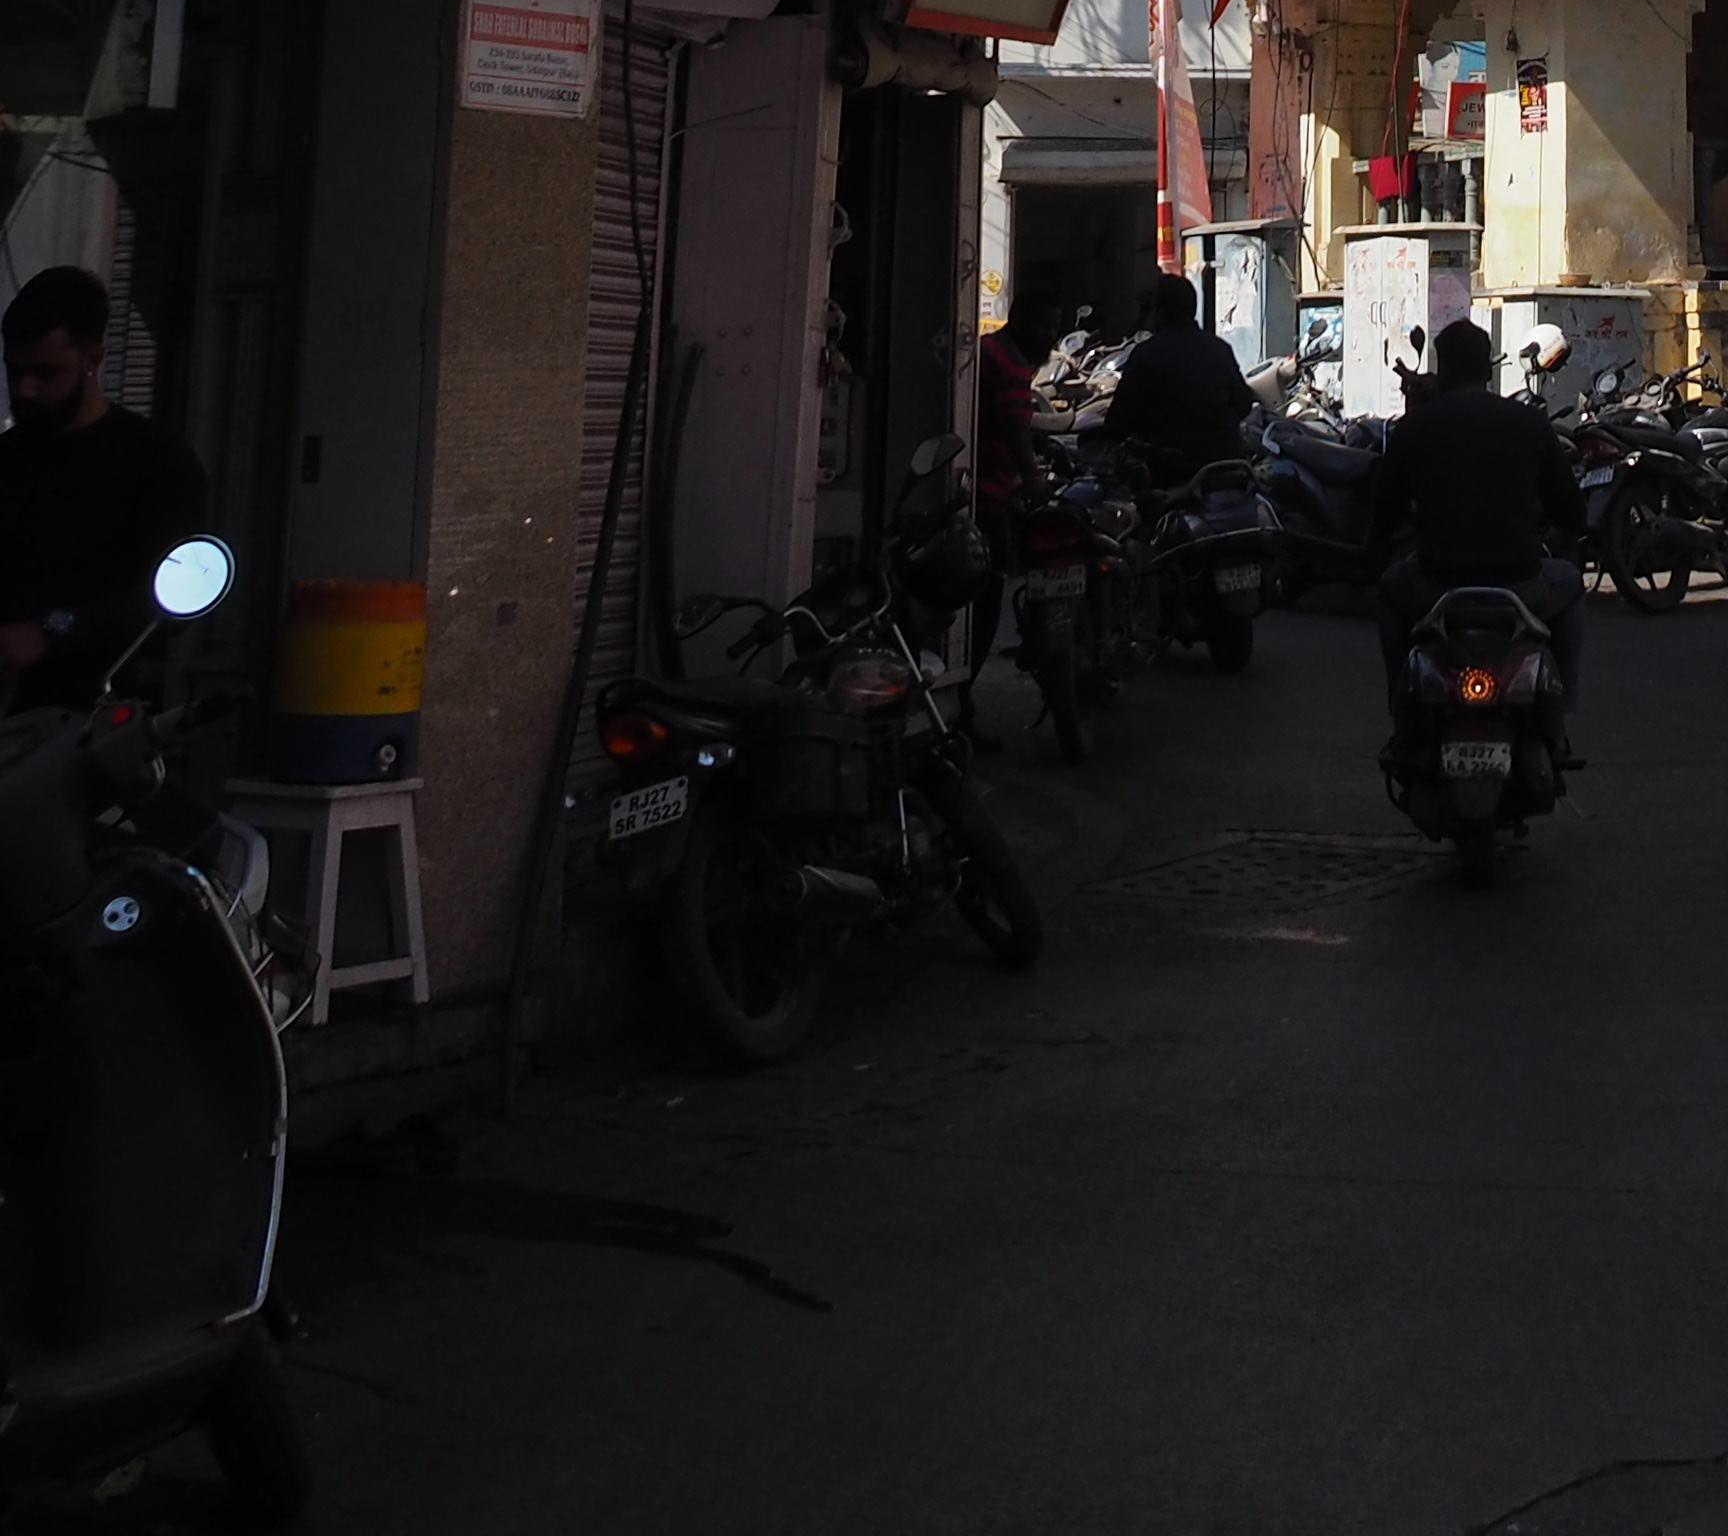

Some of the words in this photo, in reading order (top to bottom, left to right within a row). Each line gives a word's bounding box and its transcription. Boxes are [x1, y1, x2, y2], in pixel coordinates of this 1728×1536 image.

[629, 786, 669, 812] RJ27
[615, 814, 636, 834] SR
[642, 801, 682, 825] 7522
